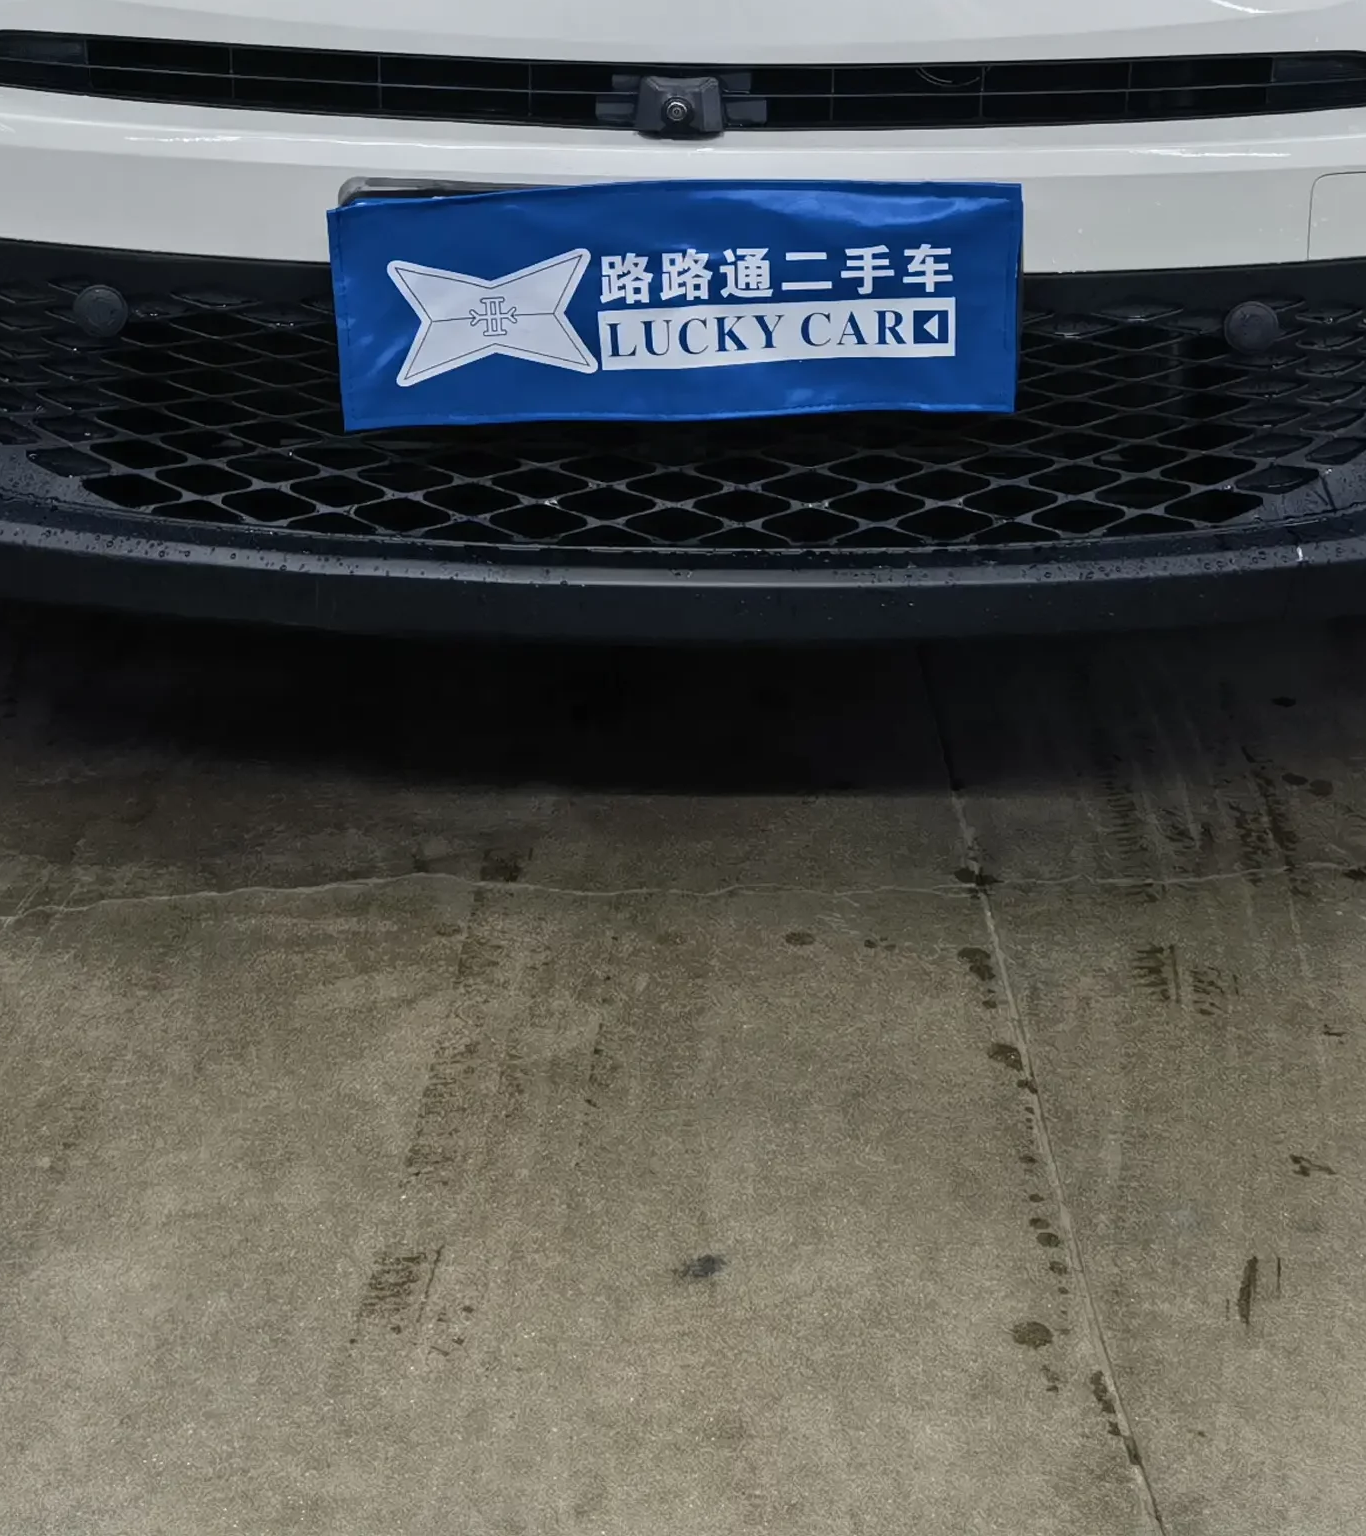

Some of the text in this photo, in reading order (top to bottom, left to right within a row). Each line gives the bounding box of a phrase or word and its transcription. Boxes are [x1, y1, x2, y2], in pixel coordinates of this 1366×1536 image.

[599, 243, 955, 305] 路路通二手车
[606, 308, 908, 358] LUCKY CAR
